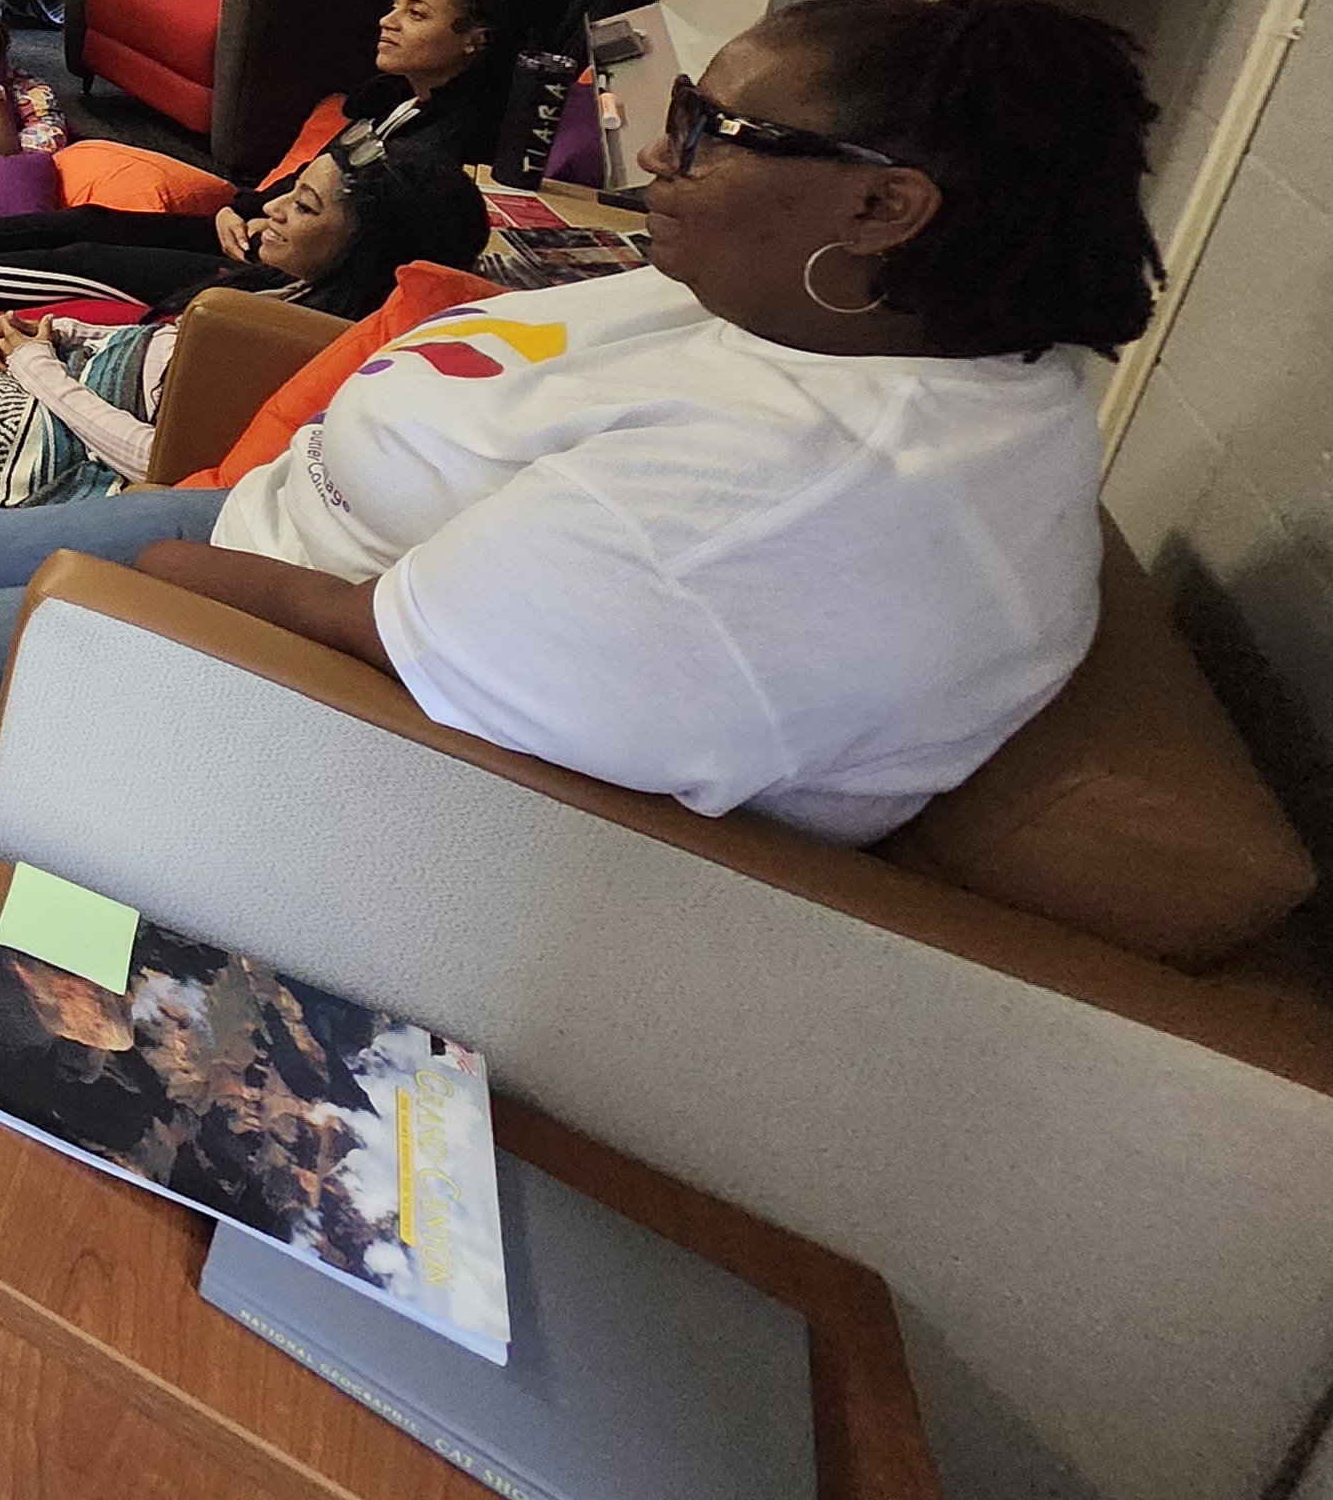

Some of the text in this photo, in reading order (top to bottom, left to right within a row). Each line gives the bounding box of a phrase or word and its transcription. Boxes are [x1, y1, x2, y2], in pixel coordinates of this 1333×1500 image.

[522, 83, 567, 172] TIARA
[414, 1069, 460, 1291] GRAND CANYON
[239, 1309, 313, 1365] NATIONAL
[319, 1363, 421, 1435] GEOGRAPHIC
[434, 1438, 475, 1470] CAT
